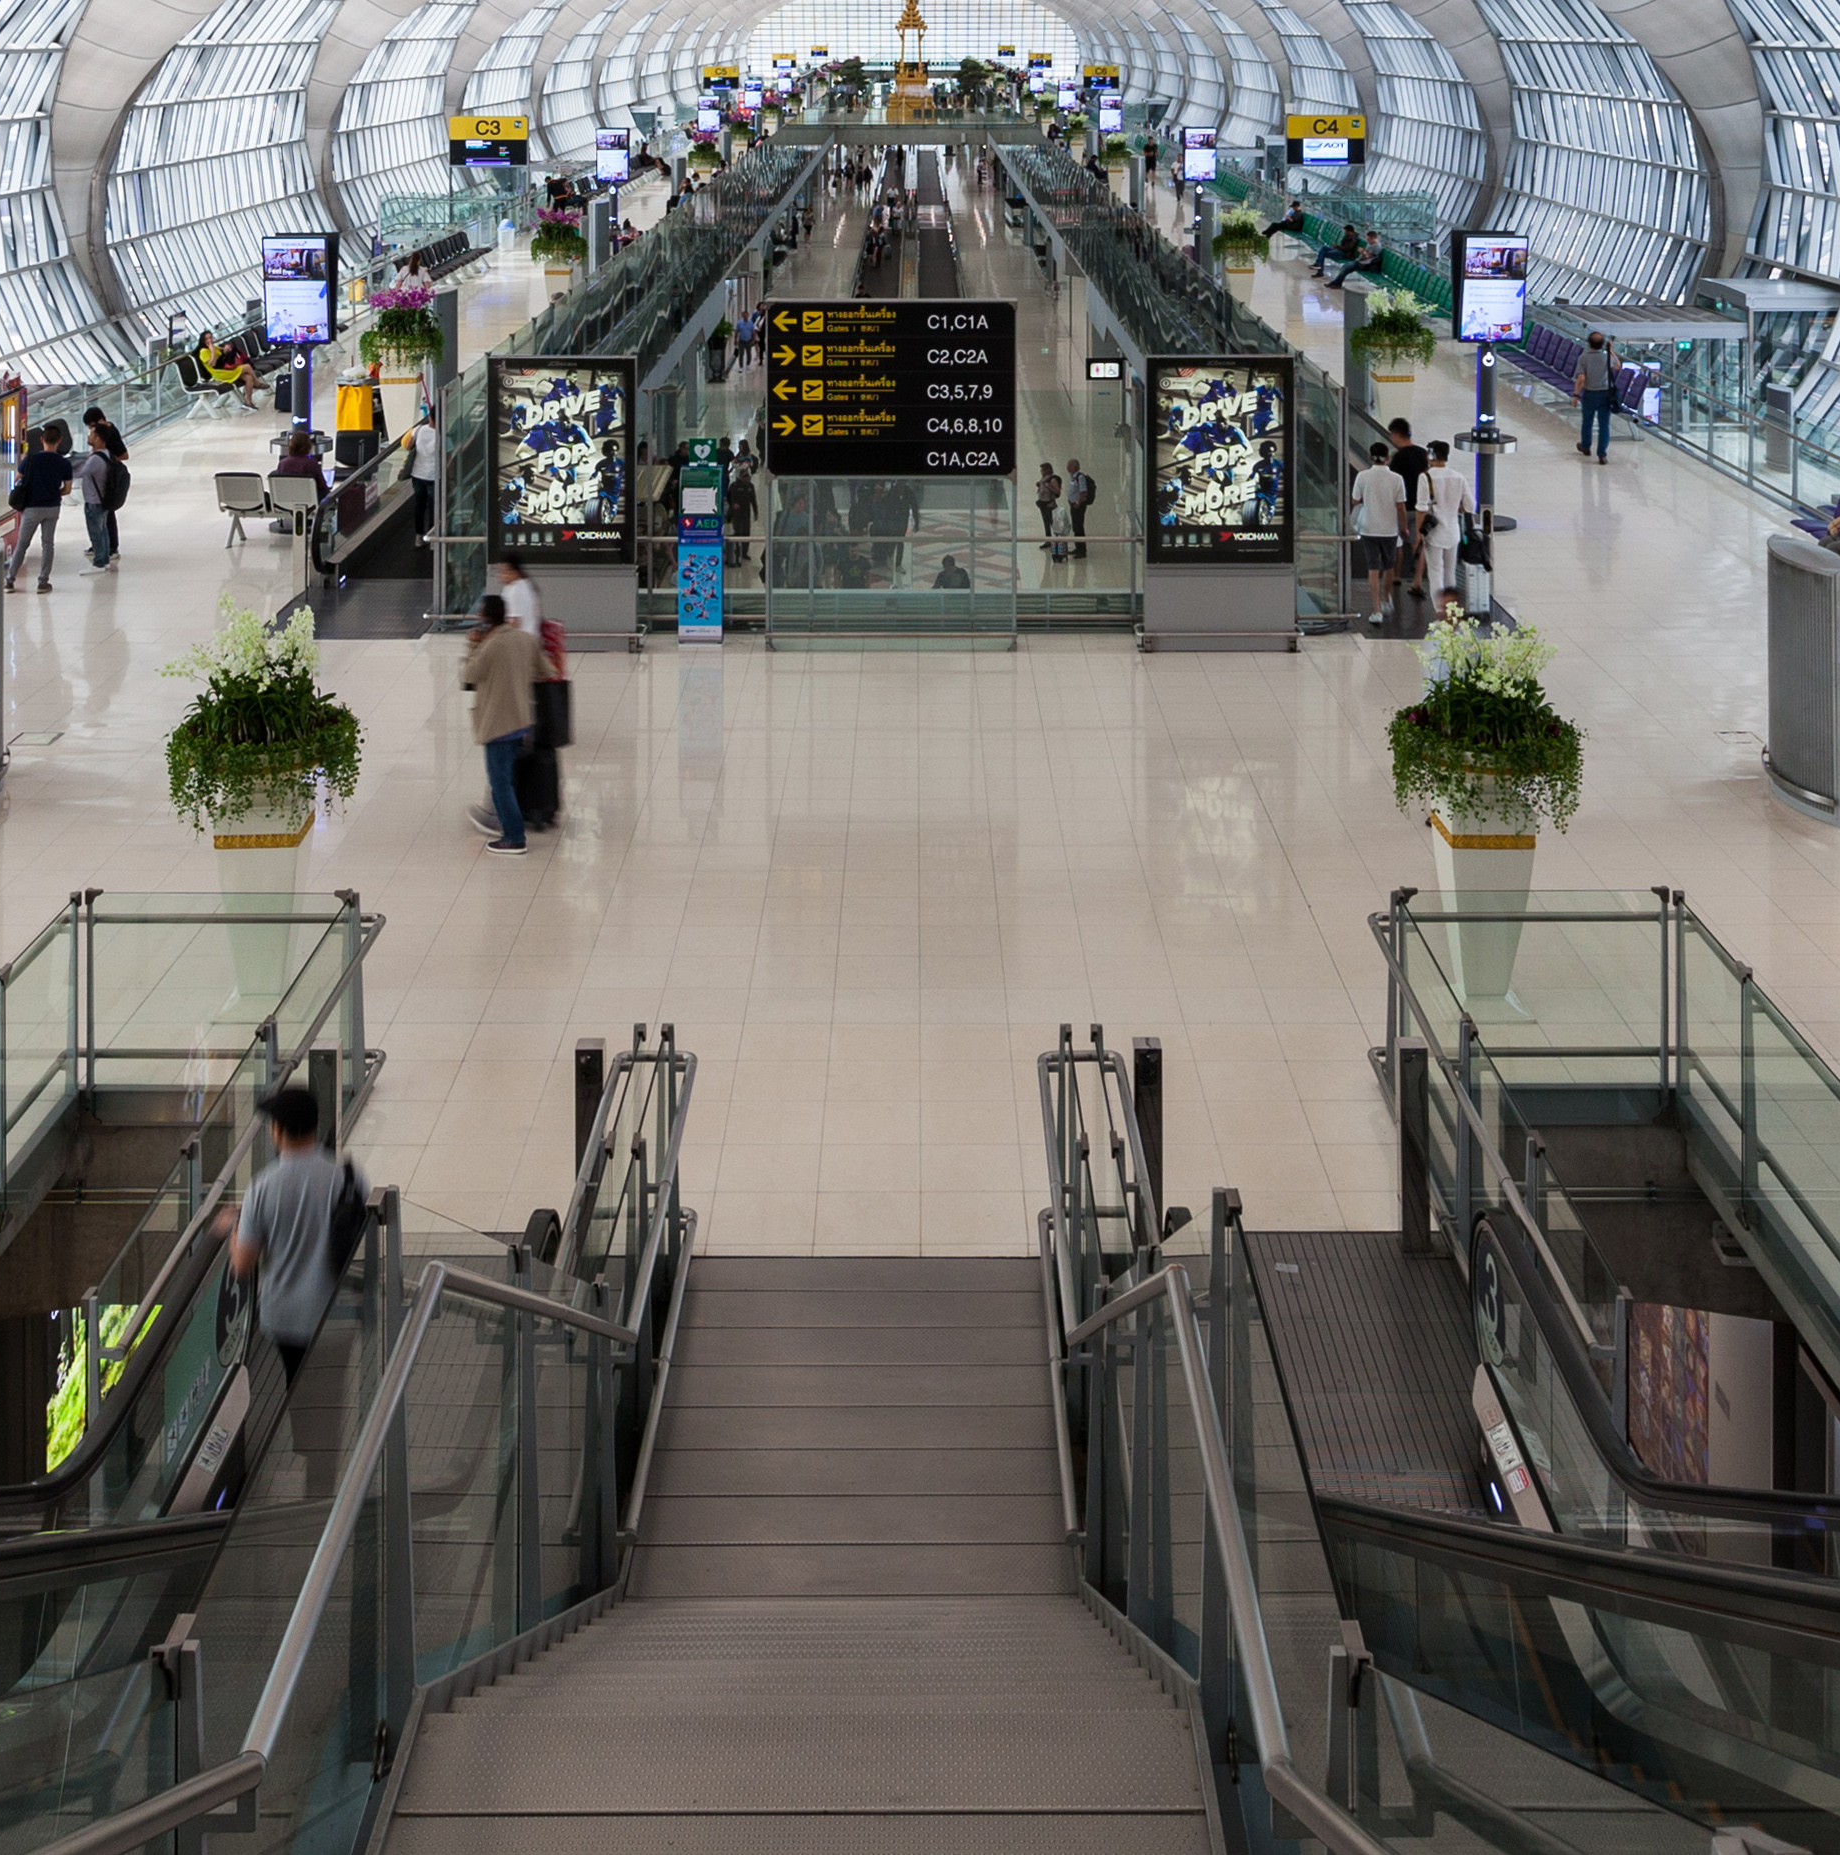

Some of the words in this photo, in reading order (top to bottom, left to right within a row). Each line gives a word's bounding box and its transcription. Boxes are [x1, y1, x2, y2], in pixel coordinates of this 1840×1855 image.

[715, 68, 727, 76] C5
[475, 120, 501, 135] C3
[1313, 119, 1339, 134] C4
[827, 325, 849, 333] Gates
[927, 314, 989, 331] C1,C1A
[827, 359, 849, 367] Gates
[927, 349, 988, 365] C2,C2A
[827, 393, 849, 401] Gates
[927, 384, 993, 401] C3,5,7,9
[525, 390, 601, 430] DRIVE
[1182, 390, 1258, 431] DRIVE
[827, 428, 849, 436] Gates
[927, 418, 1002, 435] C4,6,8,10
[537, 443, 596, 474] FOR
[927, 451, 1000, 468] C1A,C2A
[1195, 444, 1254, 474] FOR
[527, 478, 599, 515] MORE
[1185, 479, 1256, 517] MORE
[695, 519, 719, 528] AED
[575, 530, 621, 540] YOKOHAMA
[1233, 532, 1279, 541] YOKOHAMA
